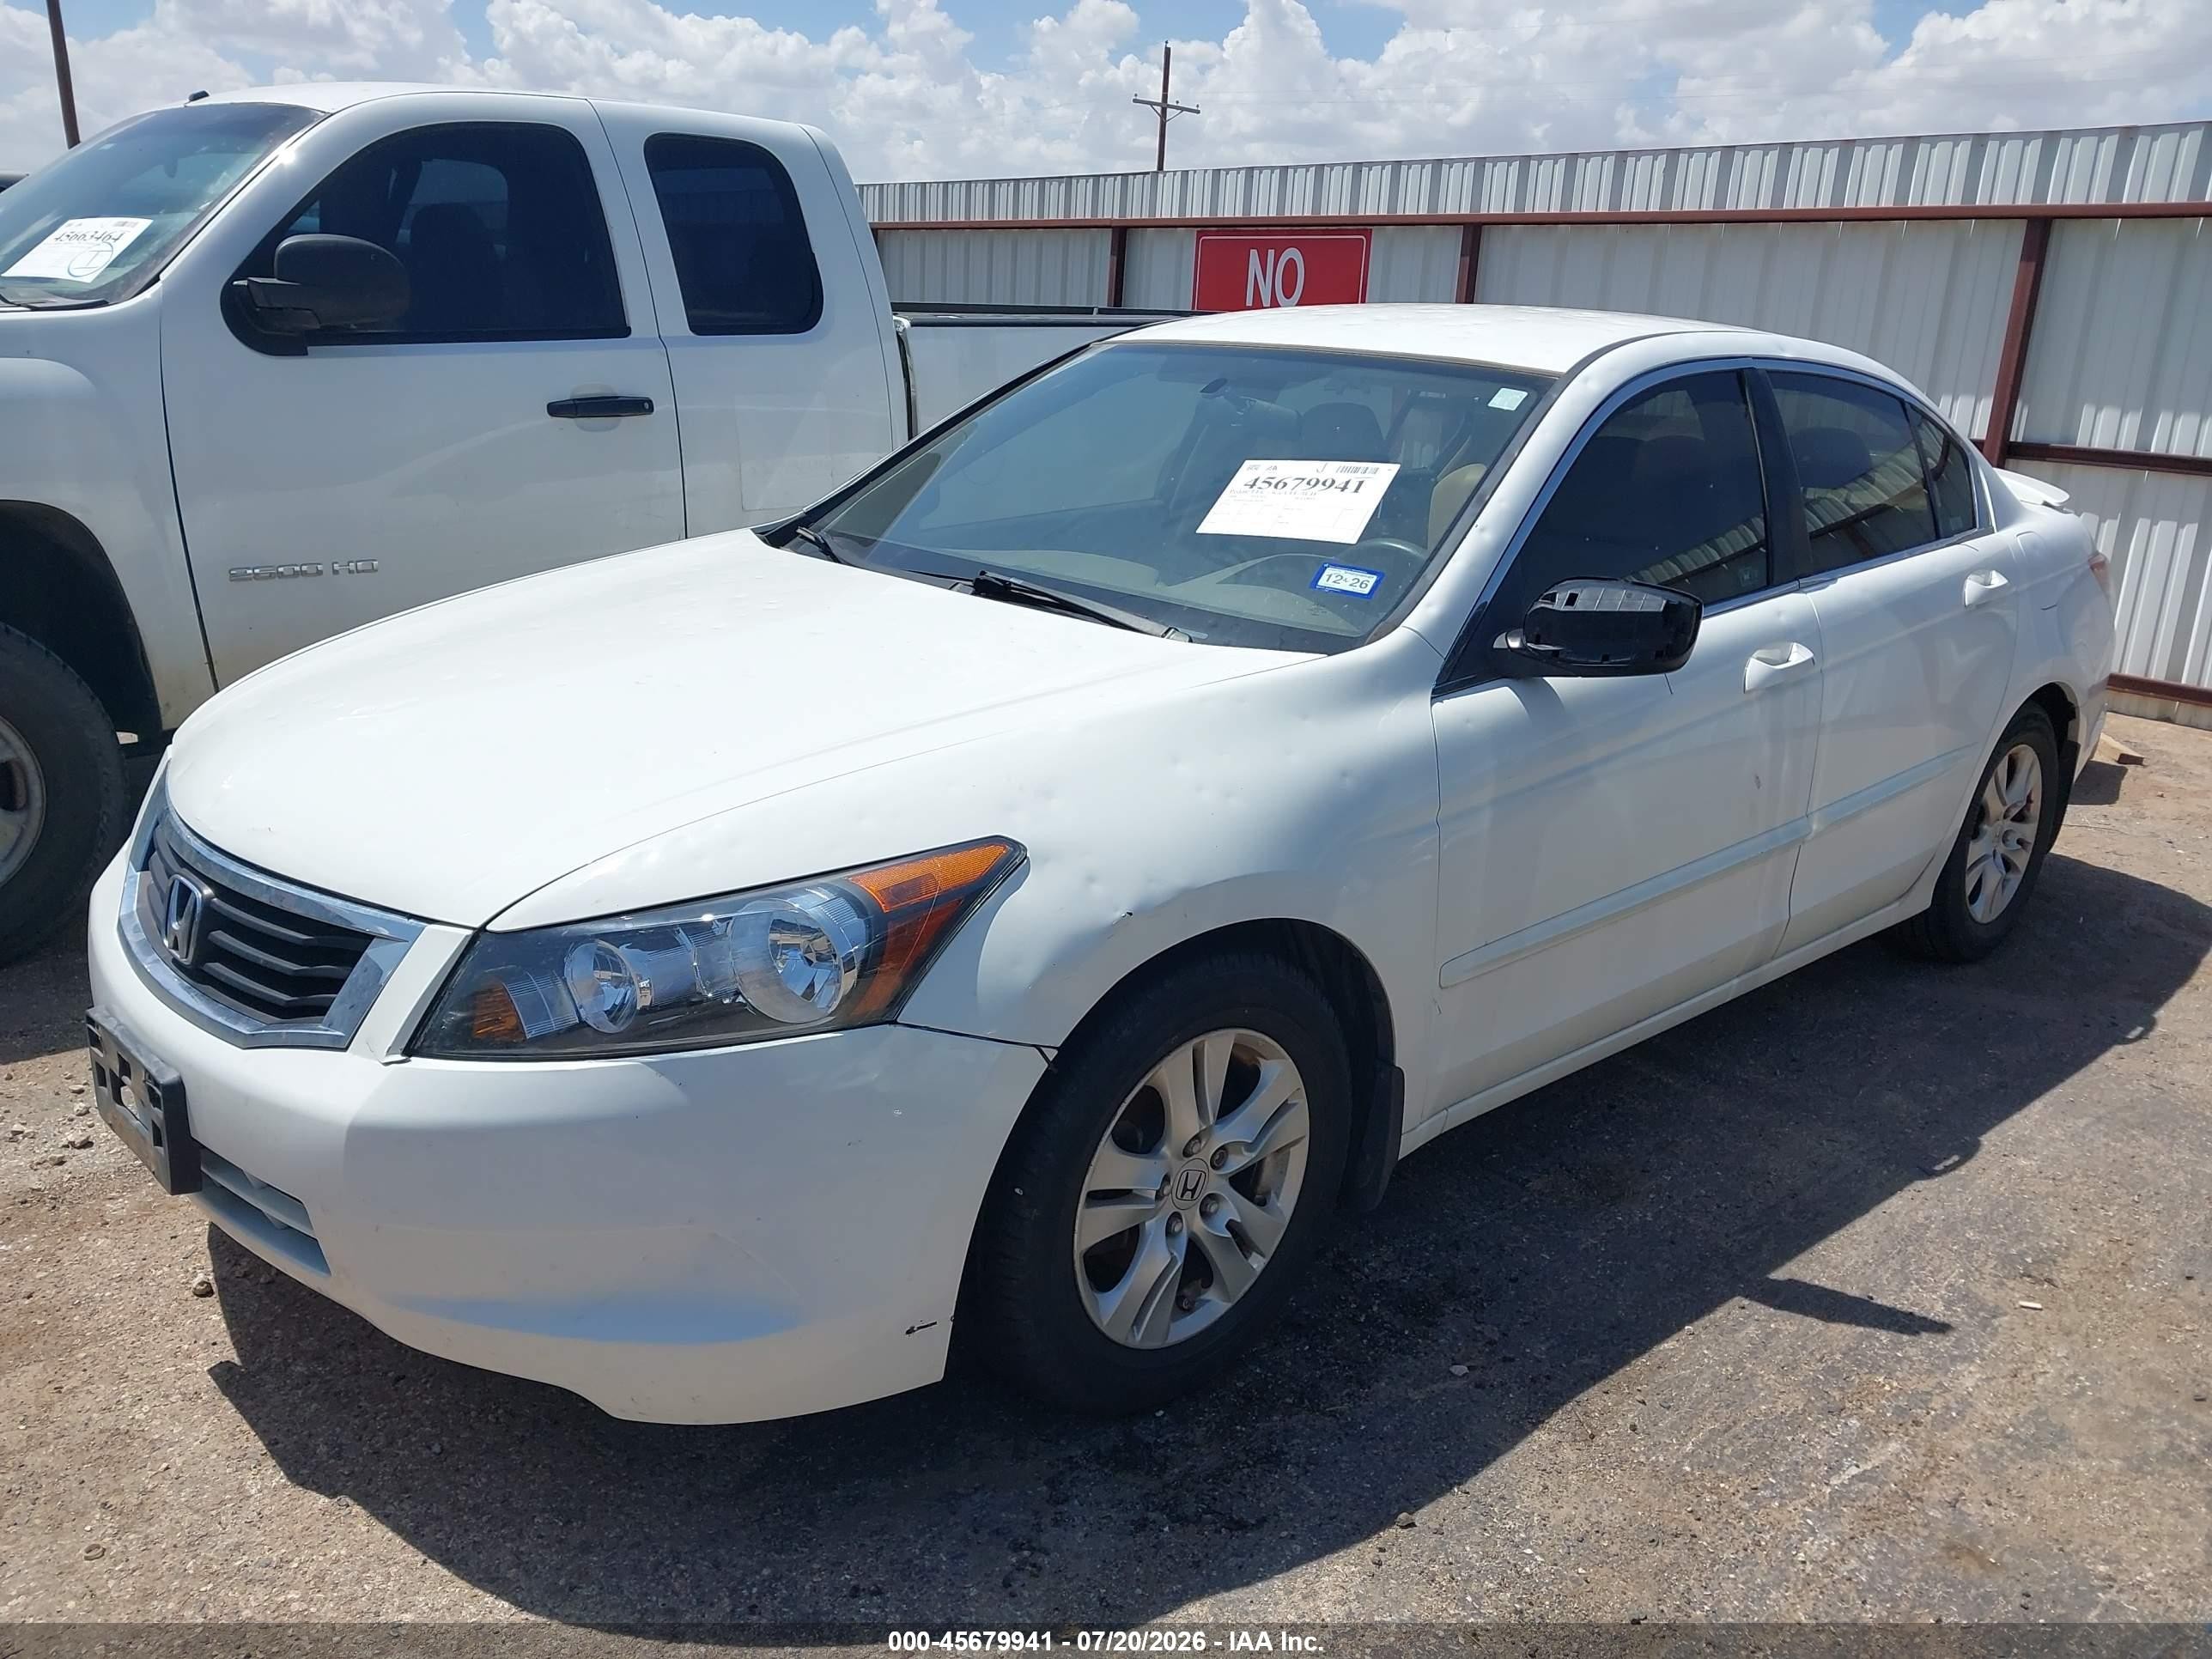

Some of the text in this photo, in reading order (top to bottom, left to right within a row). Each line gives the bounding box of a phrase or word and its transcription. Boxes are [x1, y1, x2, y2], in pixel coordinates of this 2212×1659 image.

[1246, 247, 1305, 307] NO
[1243, 476, 1366, 494] 45679941
[229, 559, 379, 582] 2500 HD
[1325, 573, 1344, 585] 12
[1348, 577, 1370, 589] 26
